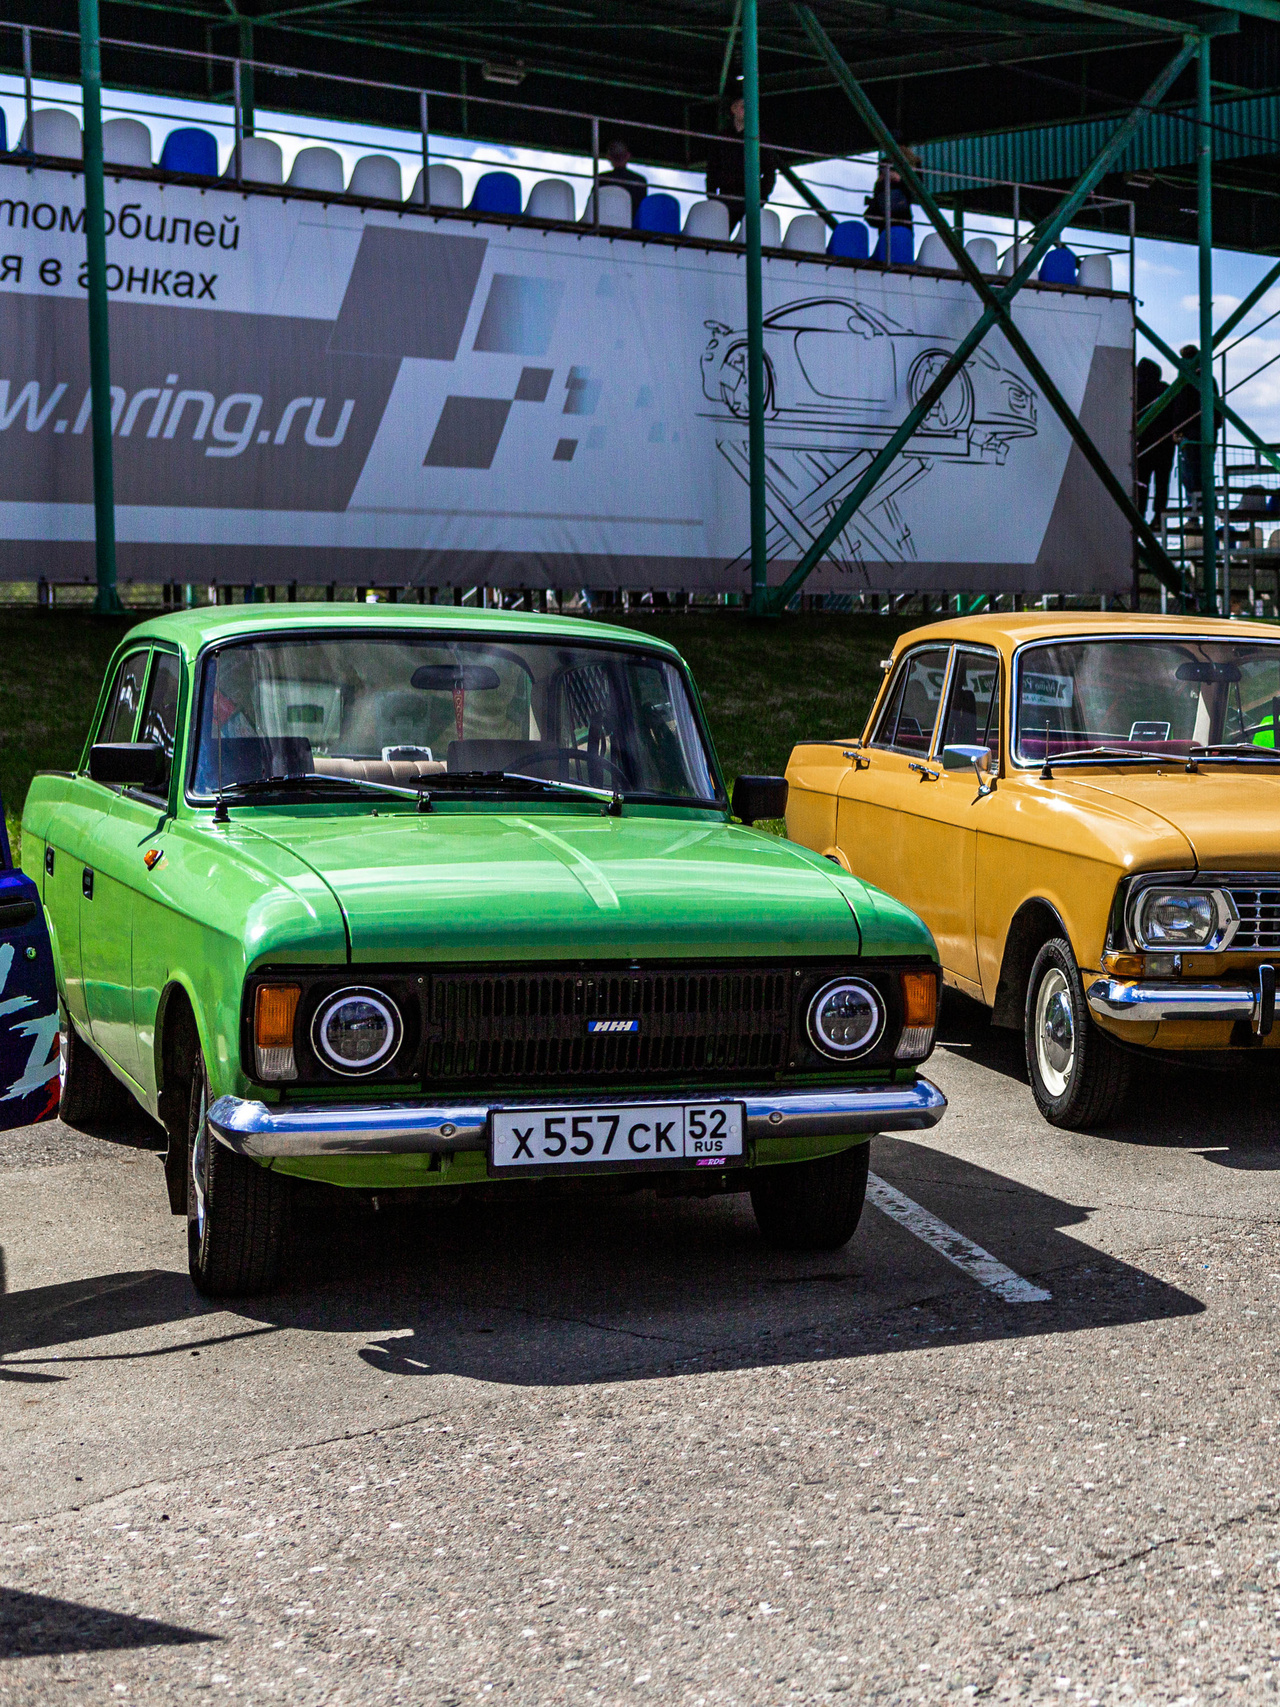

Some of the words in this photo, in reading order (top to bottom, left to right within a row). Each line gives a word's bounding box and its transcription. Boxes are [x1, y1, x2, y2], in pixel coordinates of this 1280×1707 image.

[39, 258, 62, 286] в
[511, 1115, 676, 1159] Х557СК
[688, 1109, 728, 1139] 52
[694, 1141, 724, 1153] RUS
